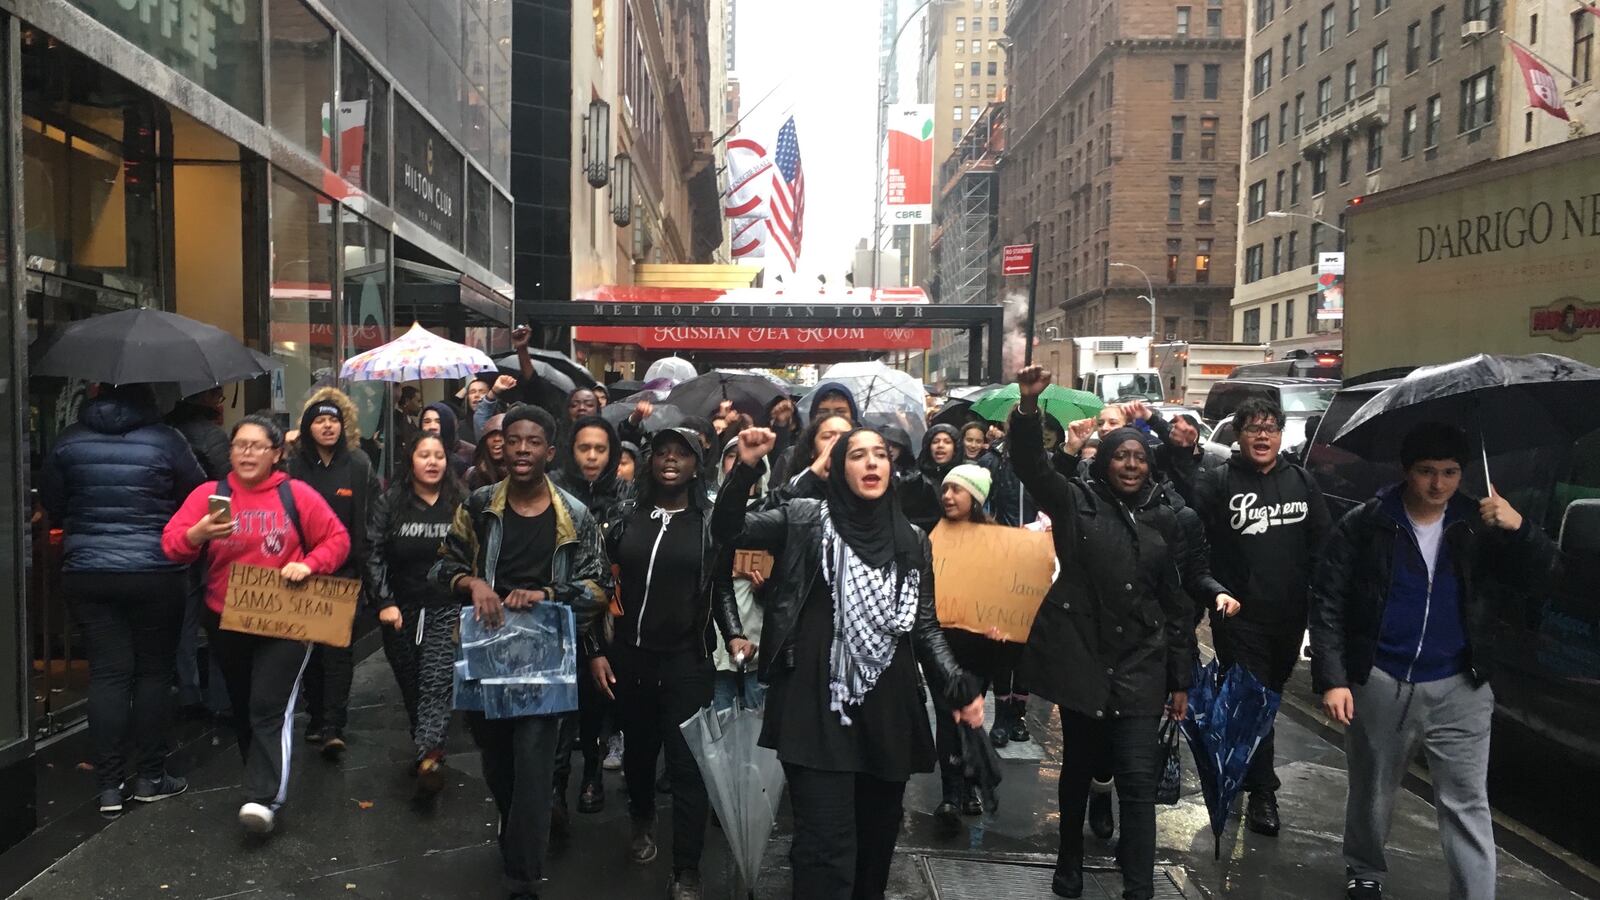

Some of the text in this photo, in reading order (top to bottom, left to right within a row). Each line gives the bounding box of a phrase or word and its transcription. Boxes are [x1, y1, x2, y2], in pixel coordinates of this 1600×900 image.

[404, 163, 453, 217] HILTON CLUB
[895, 211, 922, 219] CBRE
[1417, 201, 1554, 263] D'ARRIGO
[593, 304, 924, 318] METROPOLITAN TOWER
[654, 327, 741, 342] RUSSIAN
[748, 327, 790, 343] TEA
[797, 327, 865, 343] ROOM
